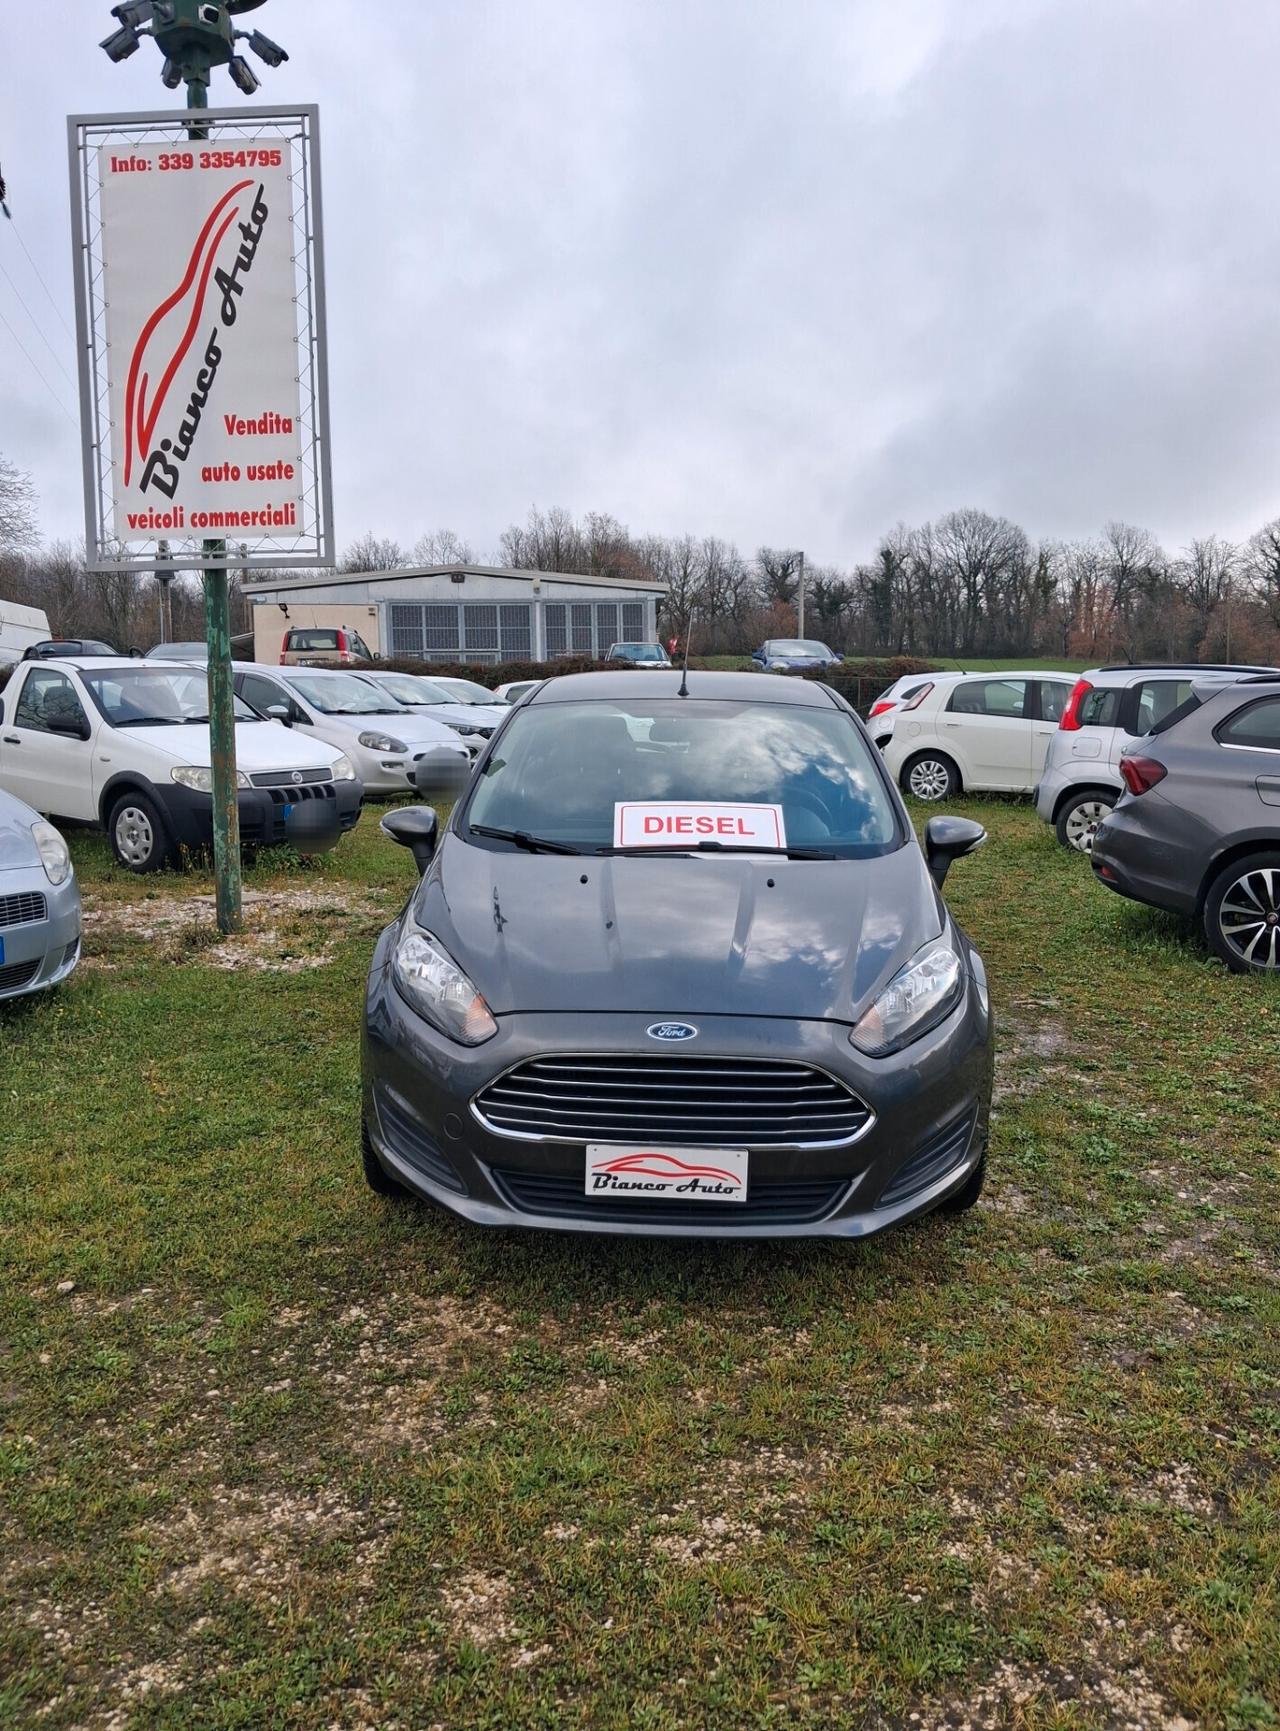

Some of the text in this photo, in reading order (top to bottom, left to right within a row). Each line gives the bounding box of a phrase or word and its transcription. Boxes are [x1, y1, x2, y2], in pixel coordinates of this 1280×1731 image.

[111, 149, 282, 172] Info: 339 3354795
[139, 183, 269, 500] Bianco Auto
[224, 411, 293, 436] Vendita
[201, 460, 294, 482] auto usate
[127, 503, 296, 529] veicoli commerciali
[644, 816, 755, 835] DIESEL
[658, 1025, 686, 1036] Ford
[592, 1173, 741, 1195] Bianco Auto
